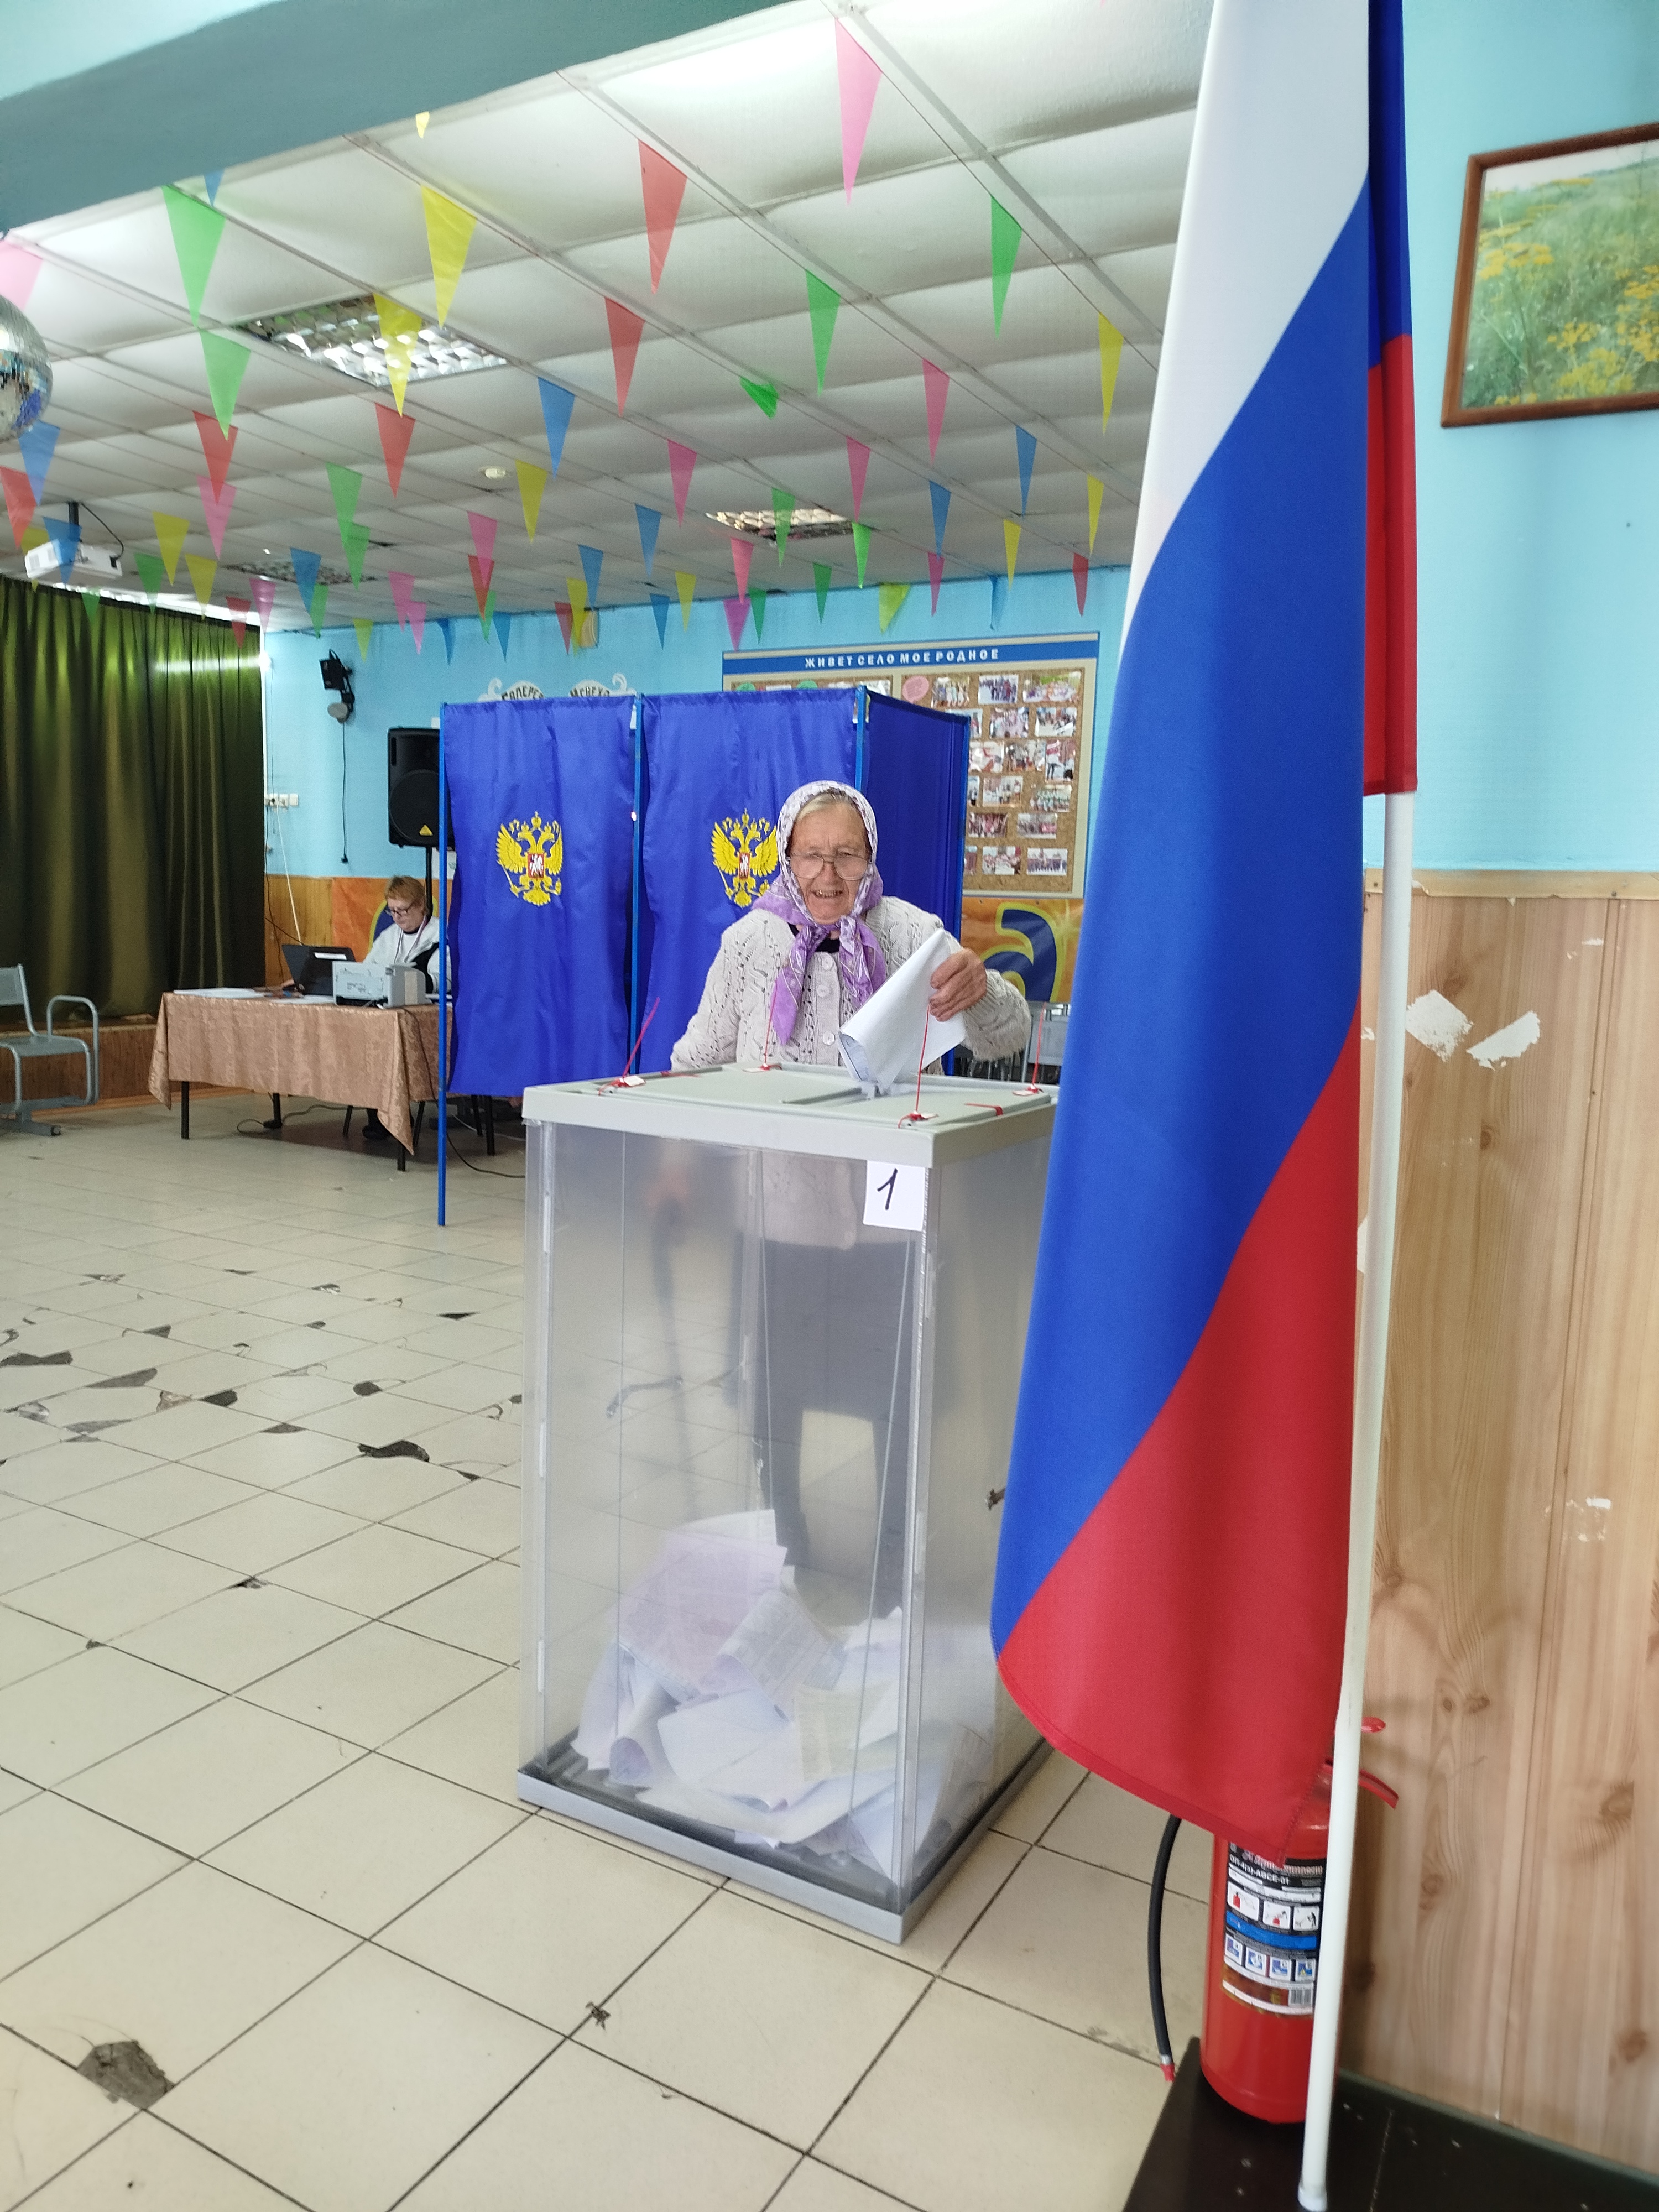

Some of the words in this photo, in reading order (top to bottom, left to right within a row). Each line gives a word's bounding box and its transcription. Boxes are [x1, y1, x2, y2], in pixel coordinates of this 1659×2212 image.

[805, 655, 853, 668] ЖИВЕТ
[857, 654, 895, 666] СЕЛО
[900, 651, 930, 664] МОЕ
[936, 648, 998, 663] РОДНОЕ
[877, 1168, 898, 1210] 1
